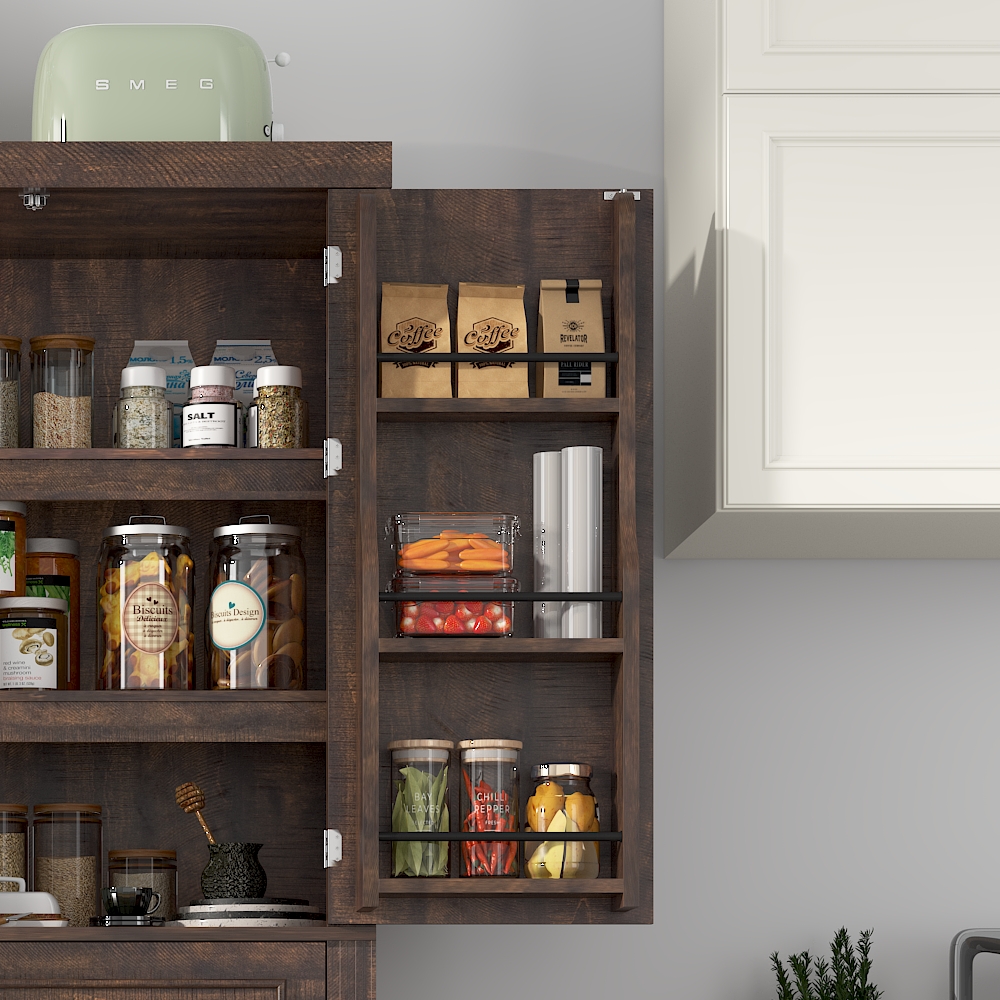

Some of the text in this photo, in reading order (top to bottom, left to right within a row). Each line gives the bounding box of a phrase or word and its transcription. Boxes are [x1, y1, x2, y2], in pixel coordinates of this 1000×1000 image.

[96, 78, 214, 90] SMEG
[388, 324, 443, 346] Coffee
[464, 324, 520, 346] Coffee
[560, 334, 588, 343] REVELATOR
[188, 412, 215, 420] SALT
[133, 605, 173, 614] Biscuits
[211, 608, 259, 619] Biscuits Design
[414, 793, 432, 801] BAY
[476, 793, 508, 801] CHILLI
[406, 805, 440, 813] LEAVES
[474, 805, 510, 814] PEPPER
